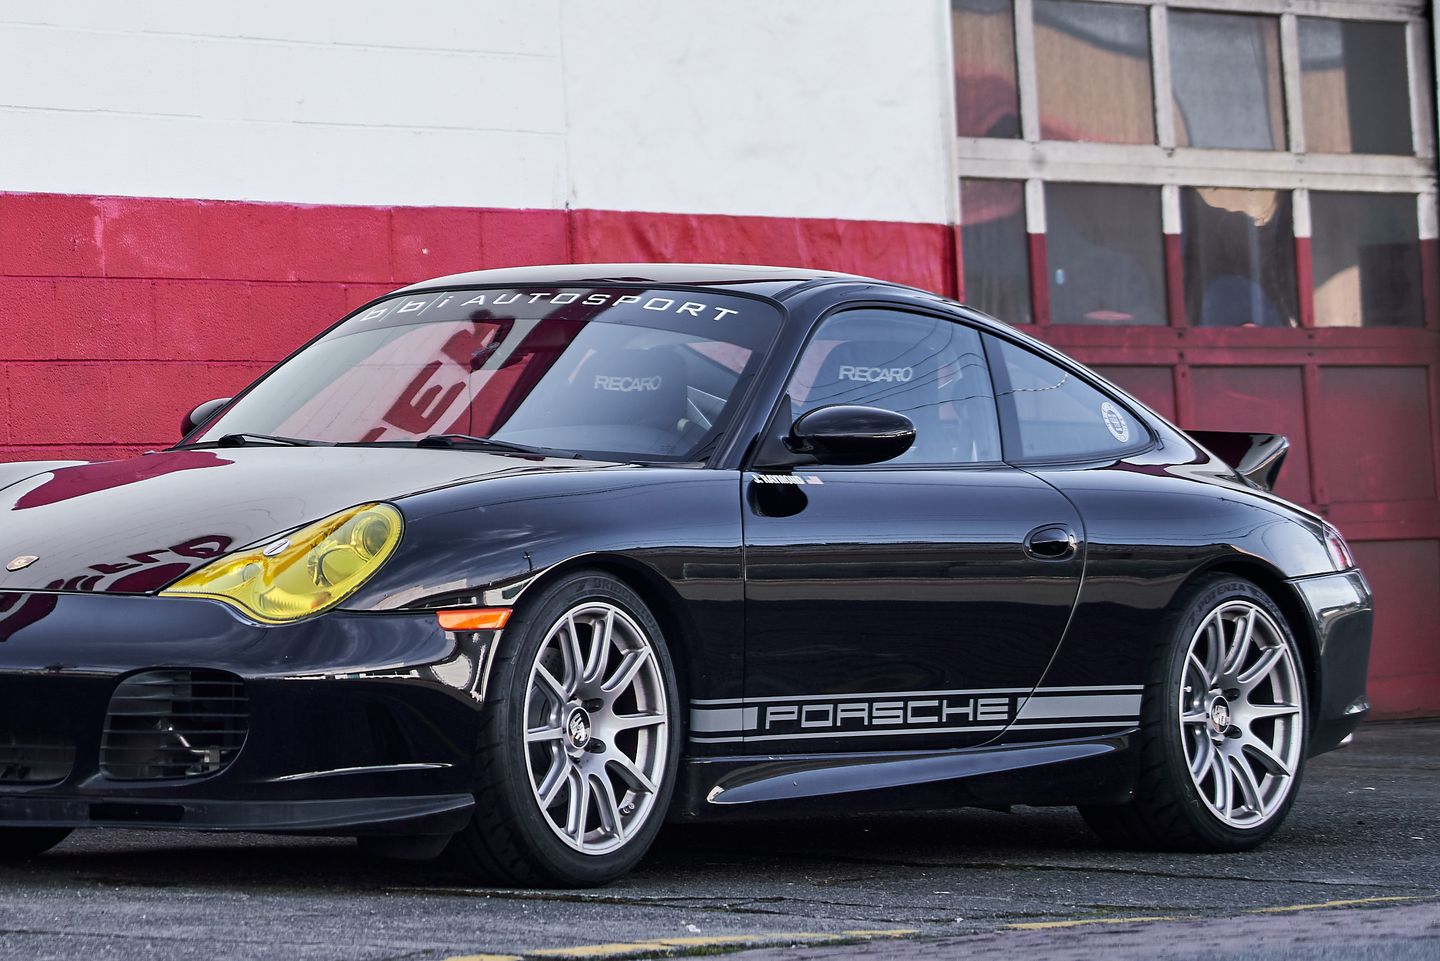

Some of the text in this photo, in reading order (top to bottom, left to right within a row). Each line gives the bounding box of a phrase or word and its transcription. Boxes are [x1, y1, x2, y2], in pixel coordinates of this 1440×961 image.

[461, 292, 739, 321] AUTOSPORT
[594, 375, 662, 392] RECARO
[838, 365, 913, 382] RECARO
[1197, 583, 1246, 612] POTENZA
[765, 698, 1009, 730] PORSCHE
